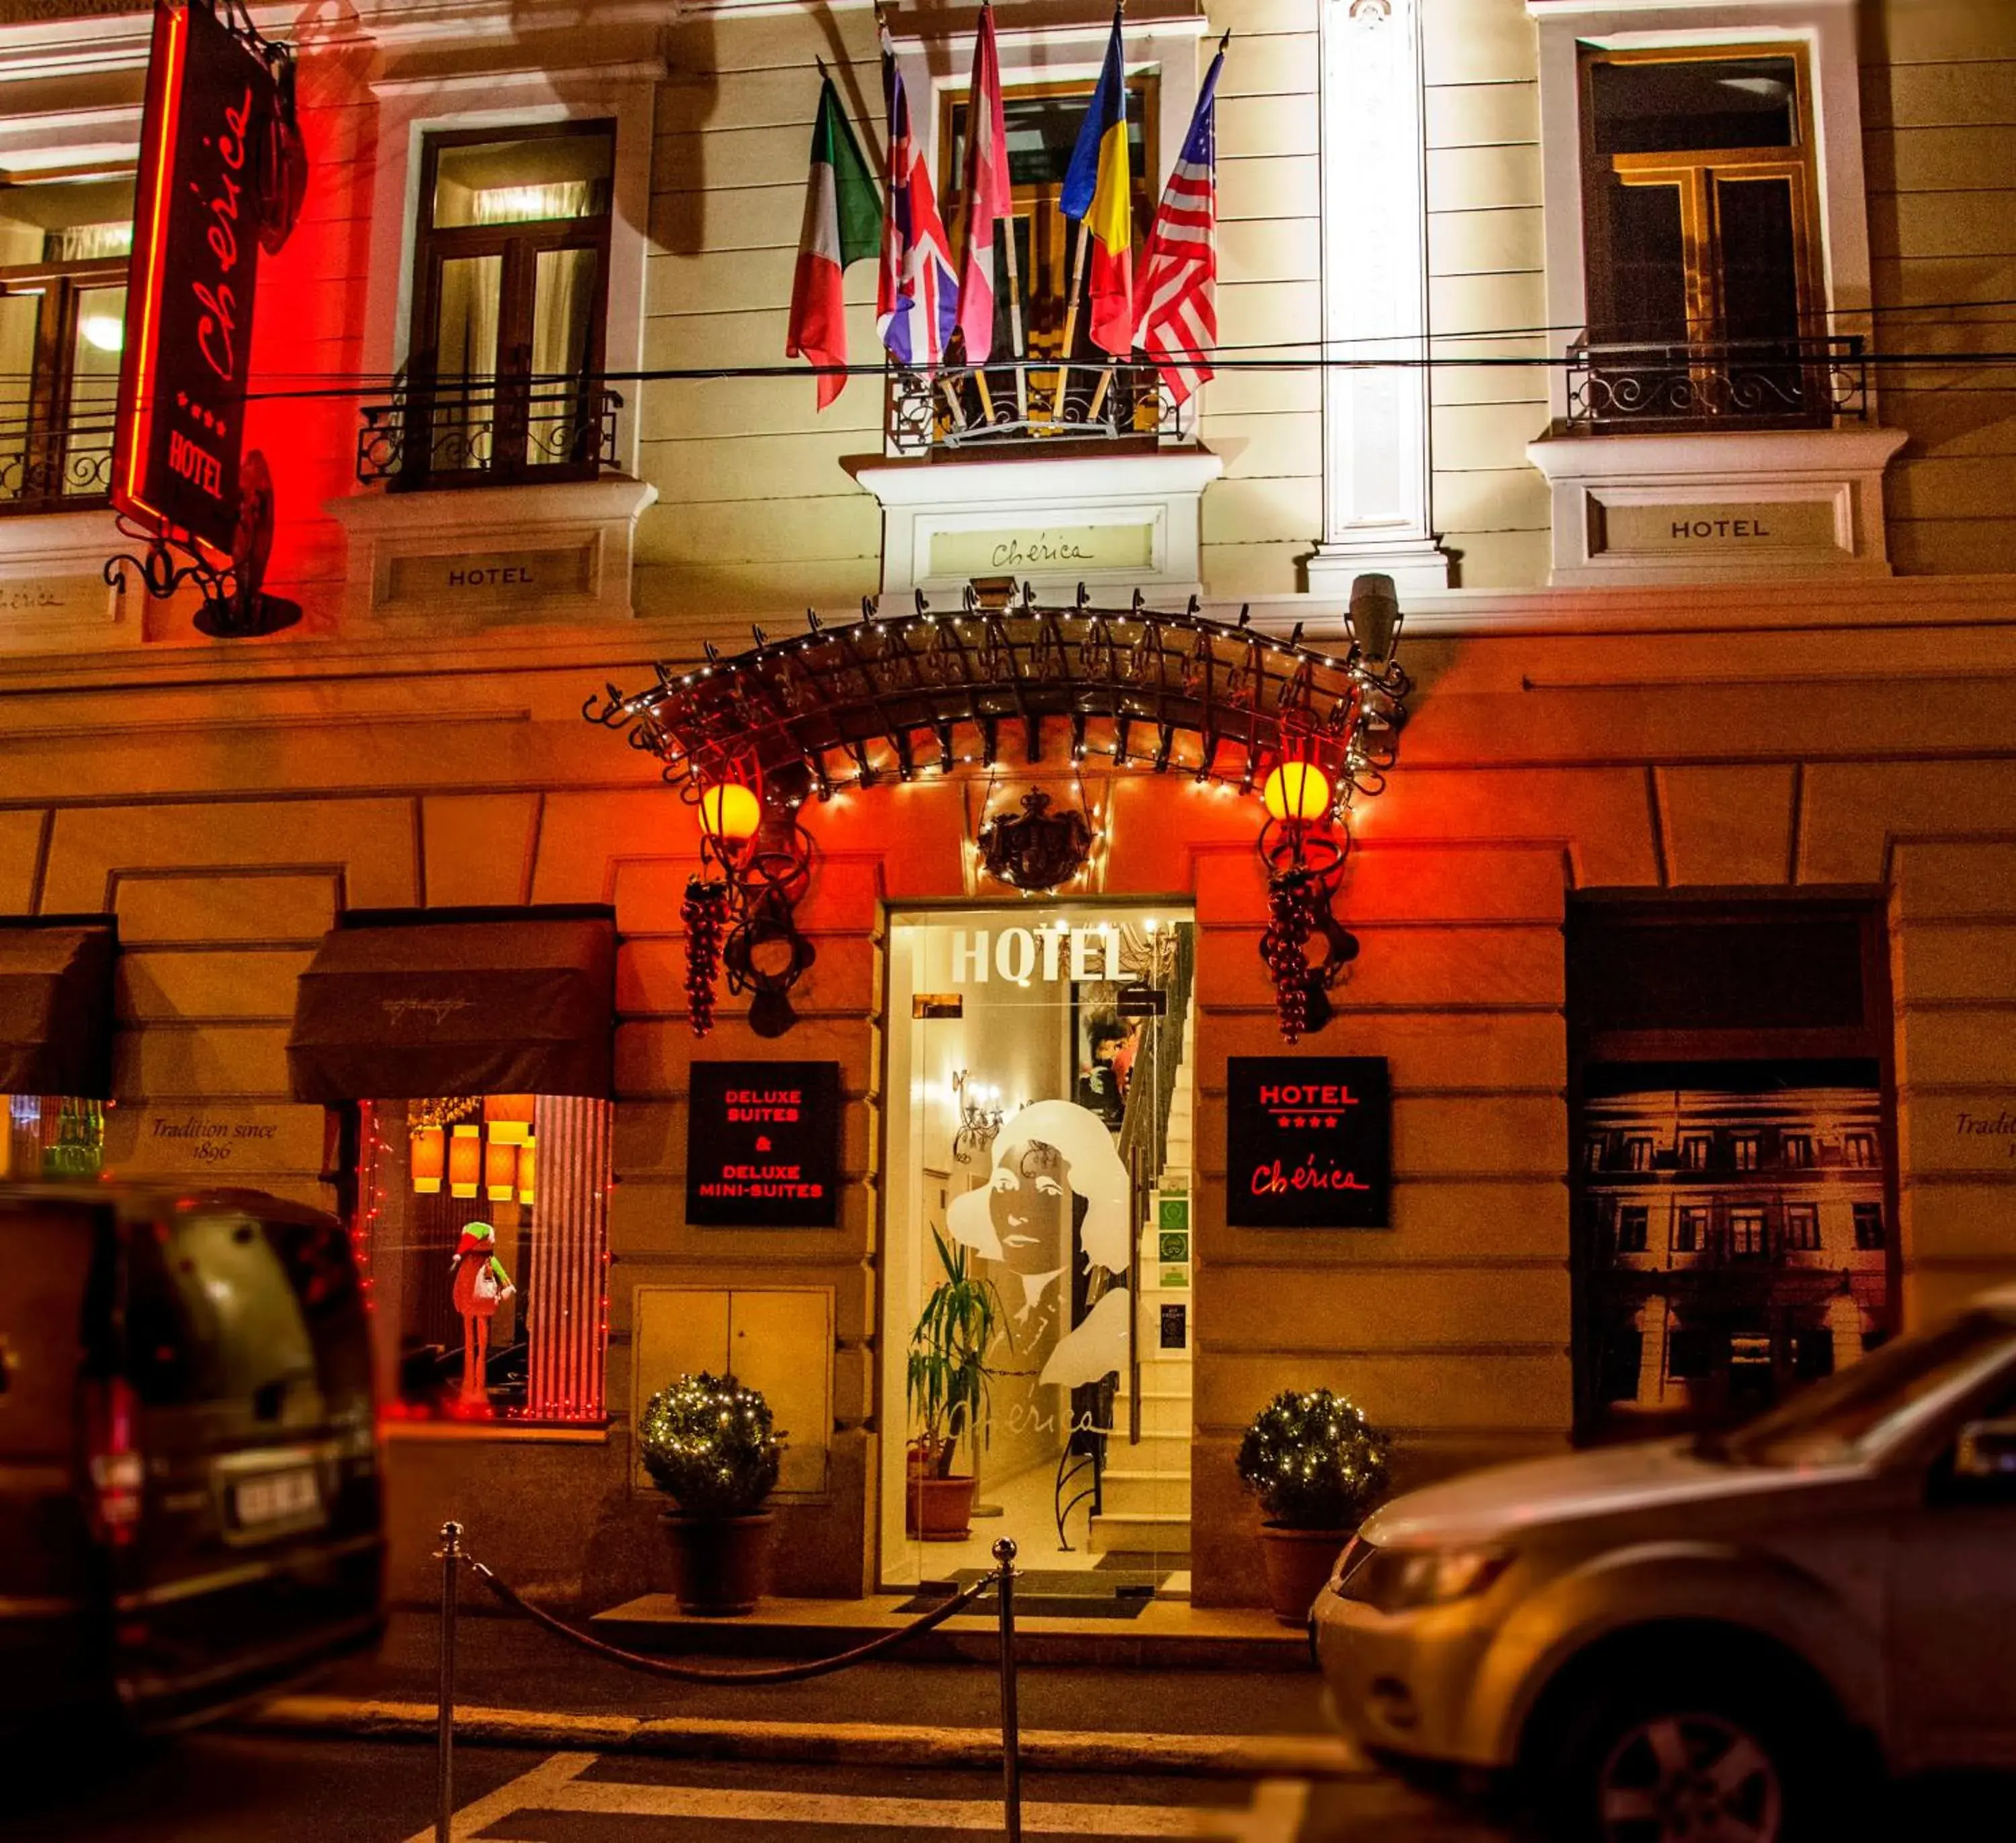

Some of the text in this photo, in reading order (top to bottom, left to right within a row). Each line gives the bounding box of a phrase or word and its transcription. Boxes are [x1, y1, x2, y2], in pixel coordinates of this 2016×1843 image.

[192, 87, 253, 381] Chérica
[169, 429, 222, 499] HOTEL
[1672, 520, 1770, 538] HOTEL
[993, 532, 1095, 567] Chérica
[450, 568, 534, 586] HOTEL
[952, 928, 1138, 983] HOTEL
[725, 1090, 802, 1104] DELUXE
[1260, 1086, 1359, 1104] HOTEL
[727, 1108, 799, 1122] SUITES
[154, 1116, 278, 1139] Tradition since
[755, 1135, 771, 1152] &
[722, 1165, 800, 1179] DELUXE
[1251, 1153, 1370, 1195] Chérica
[700, 1184, 823, 1198] MINI-SUITES
